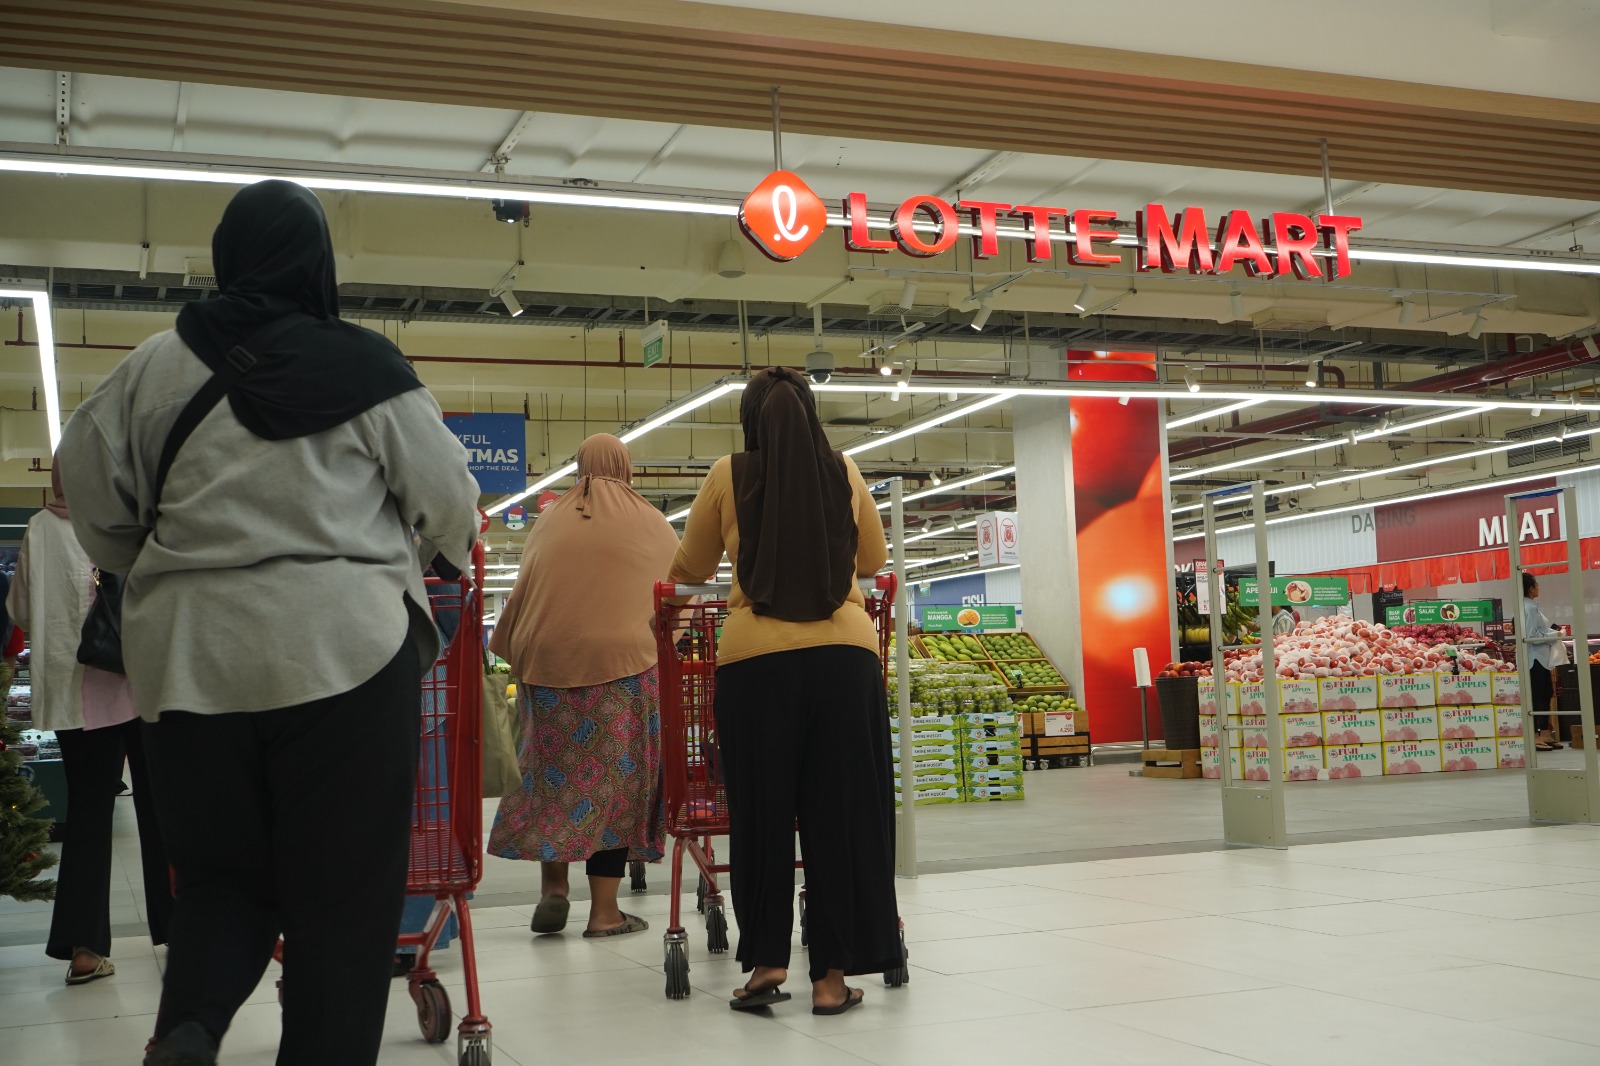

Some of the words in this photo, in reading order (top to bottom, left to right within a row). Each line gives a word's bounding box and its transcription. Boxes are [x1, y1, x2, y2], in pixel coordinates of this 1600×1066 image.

[848, 191, 1122, 264] LOTTE
[1146, 203, 1363, 279] MART
[455, 434, 491, 445] FUL
[466, 448, 519, 464] TMAS
[1351, 505, 1416, 534] DAGING
[1398, 683, 1431, 691] APPLES
[1455, 680, 1487, 688] APPLES
[1338, 686, 1372, 694] APPLES
[1452, 709, 1472, 717] FUJI
[1398, 717, 1433, 725] APPLES
[1456, 714, 1489, 723] APPLES
[1342, 720, 1375, 728] APPLES
[1397, 744, 1418, 752] FUJI
[1454, 741, 1474, 749] FUJI
[1252, 750, 1267, 758] FUJI
[1401, 749, 1436, 758] APPLES
[1458, 746, 1492, 755] APPLES
[1343, 753, 1377, 761] APPLES
